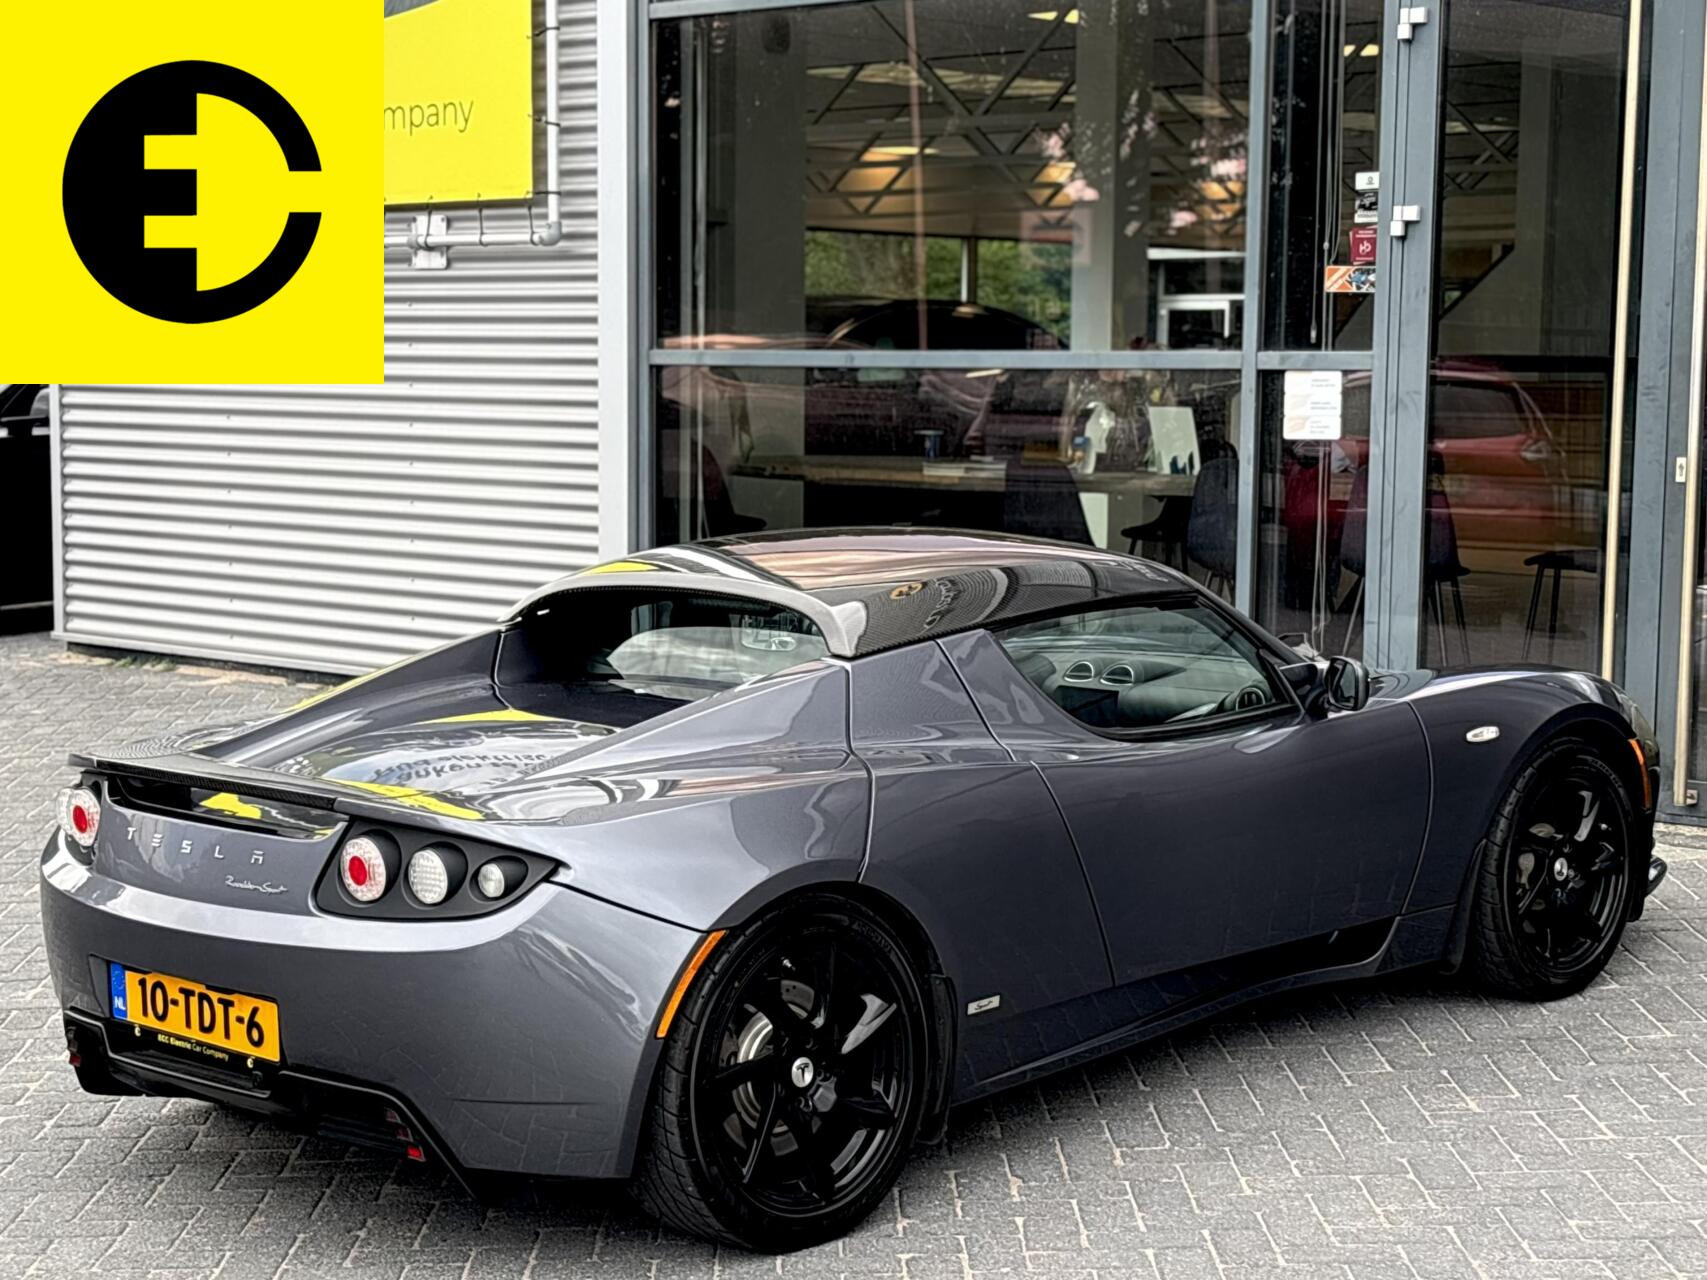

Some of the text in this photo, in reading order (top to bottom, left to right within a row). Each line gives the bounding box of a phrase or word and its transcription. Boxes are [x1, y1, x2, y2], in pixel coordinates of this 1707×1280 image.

[127, 827, 264, 865] TESLA
[114, 996, 126, 1011] NL
[138, 977, 265, 1048] 10-TDT-6
[192, 1043, 202, 1052] Car
[202, 1046, 229, 1062] Company
